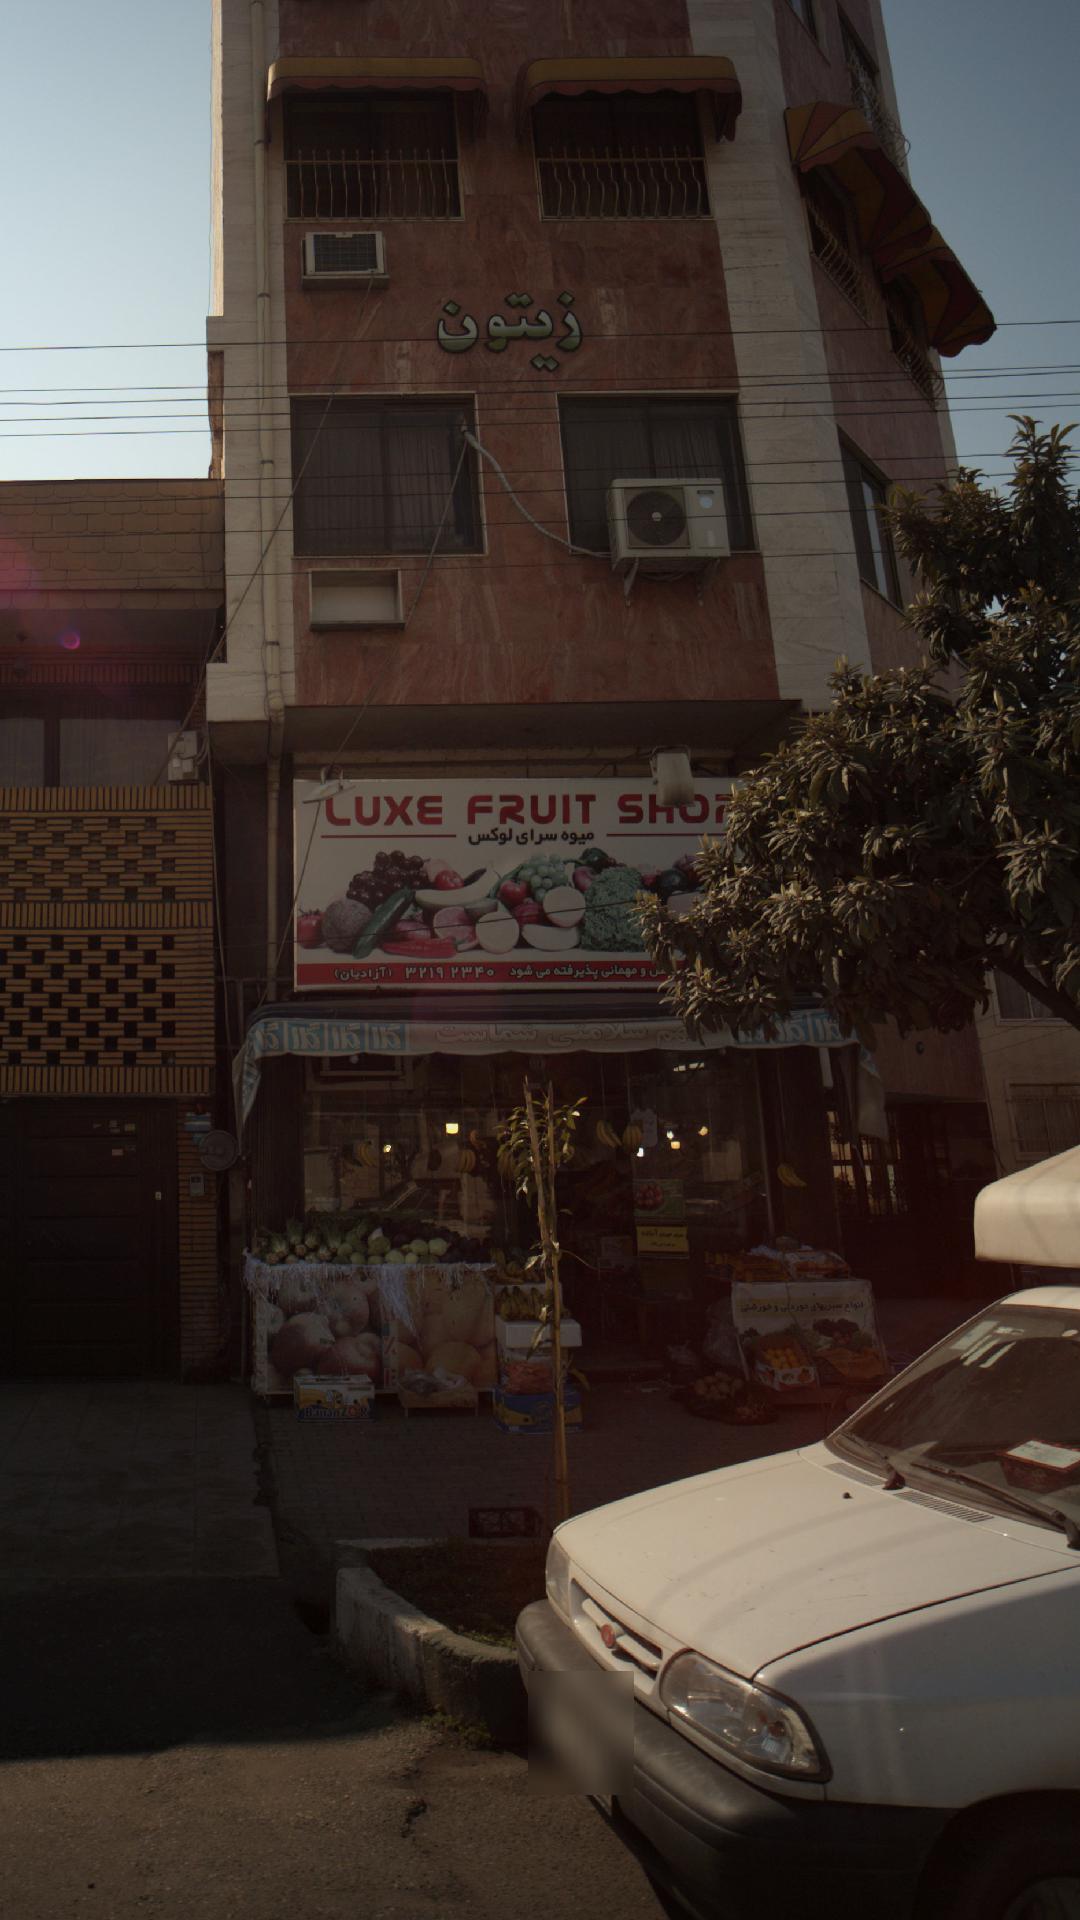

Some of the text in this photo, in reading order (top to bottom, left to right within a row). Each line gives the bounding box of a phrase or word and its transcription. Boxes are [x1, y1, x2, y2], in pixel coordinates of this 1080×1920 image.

[437, 291, 582, 372] زیتون
[325, 795, 443, 827] LUXE
[467, 794, 596, 825] FRUIT
[468, 828, 594, 845] میوه سرای لوکس
[405, 967, 444, 980] ۳۲۱۹
[510, 965, 533, 979] شود
[553, 965, 599, 981] پذیرفته
[600, 966, 637, 978] مهمانی
